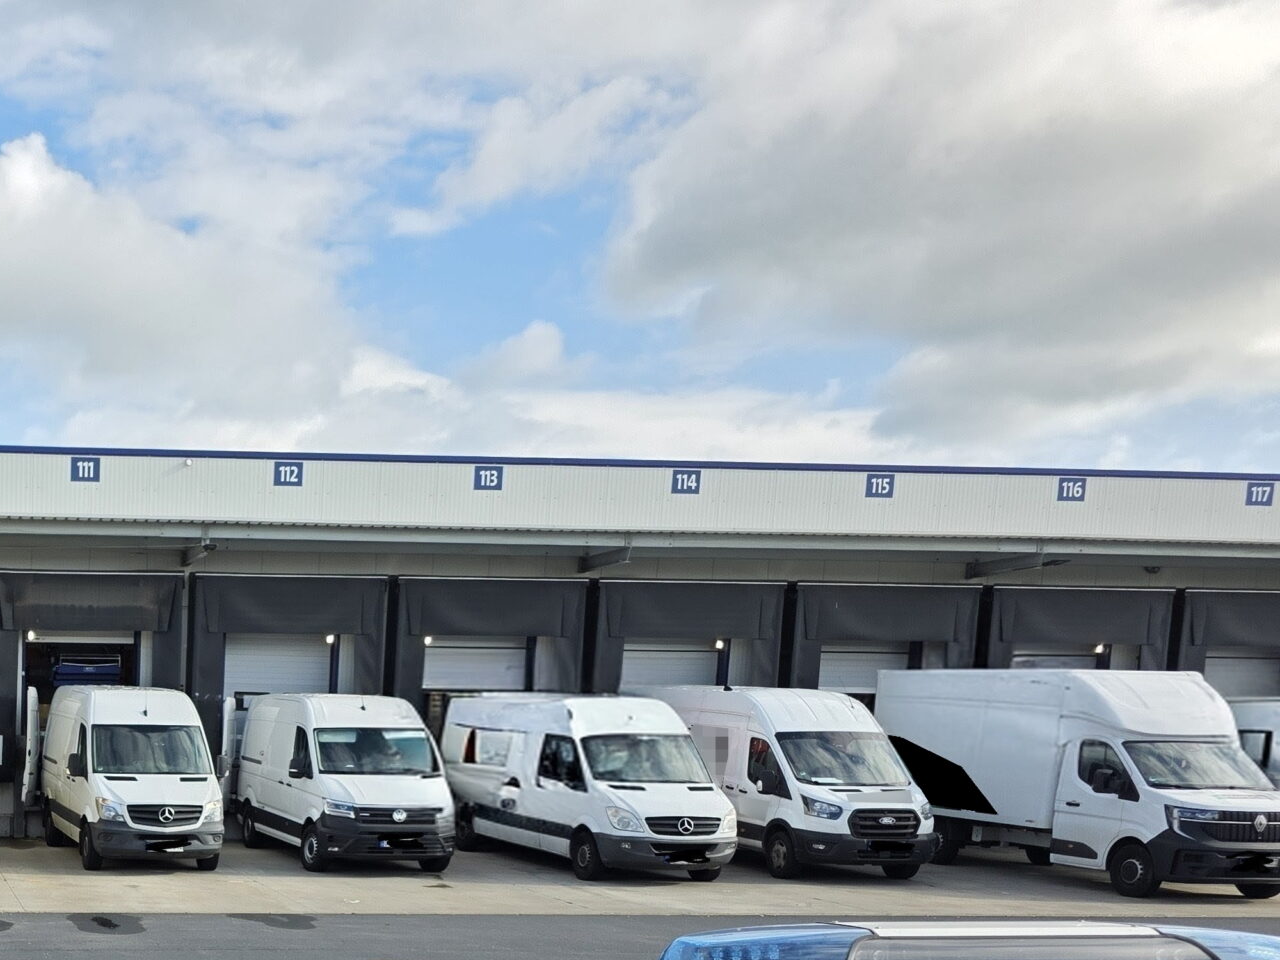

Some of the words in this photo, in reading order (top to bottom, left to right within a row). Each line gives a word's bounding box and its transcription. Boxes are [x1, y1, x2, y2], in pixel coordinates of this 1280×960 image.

[77, 461, 94, 477] 111
[278, 466, 299, 483] 112
[478, 471, 498, 487] 113
[676, 474, 697, 490] 114
[870, 478, 890, 493] 115
[1063, 481, 1083, 497] 116
[1251, 486, 1271, 502] 117
